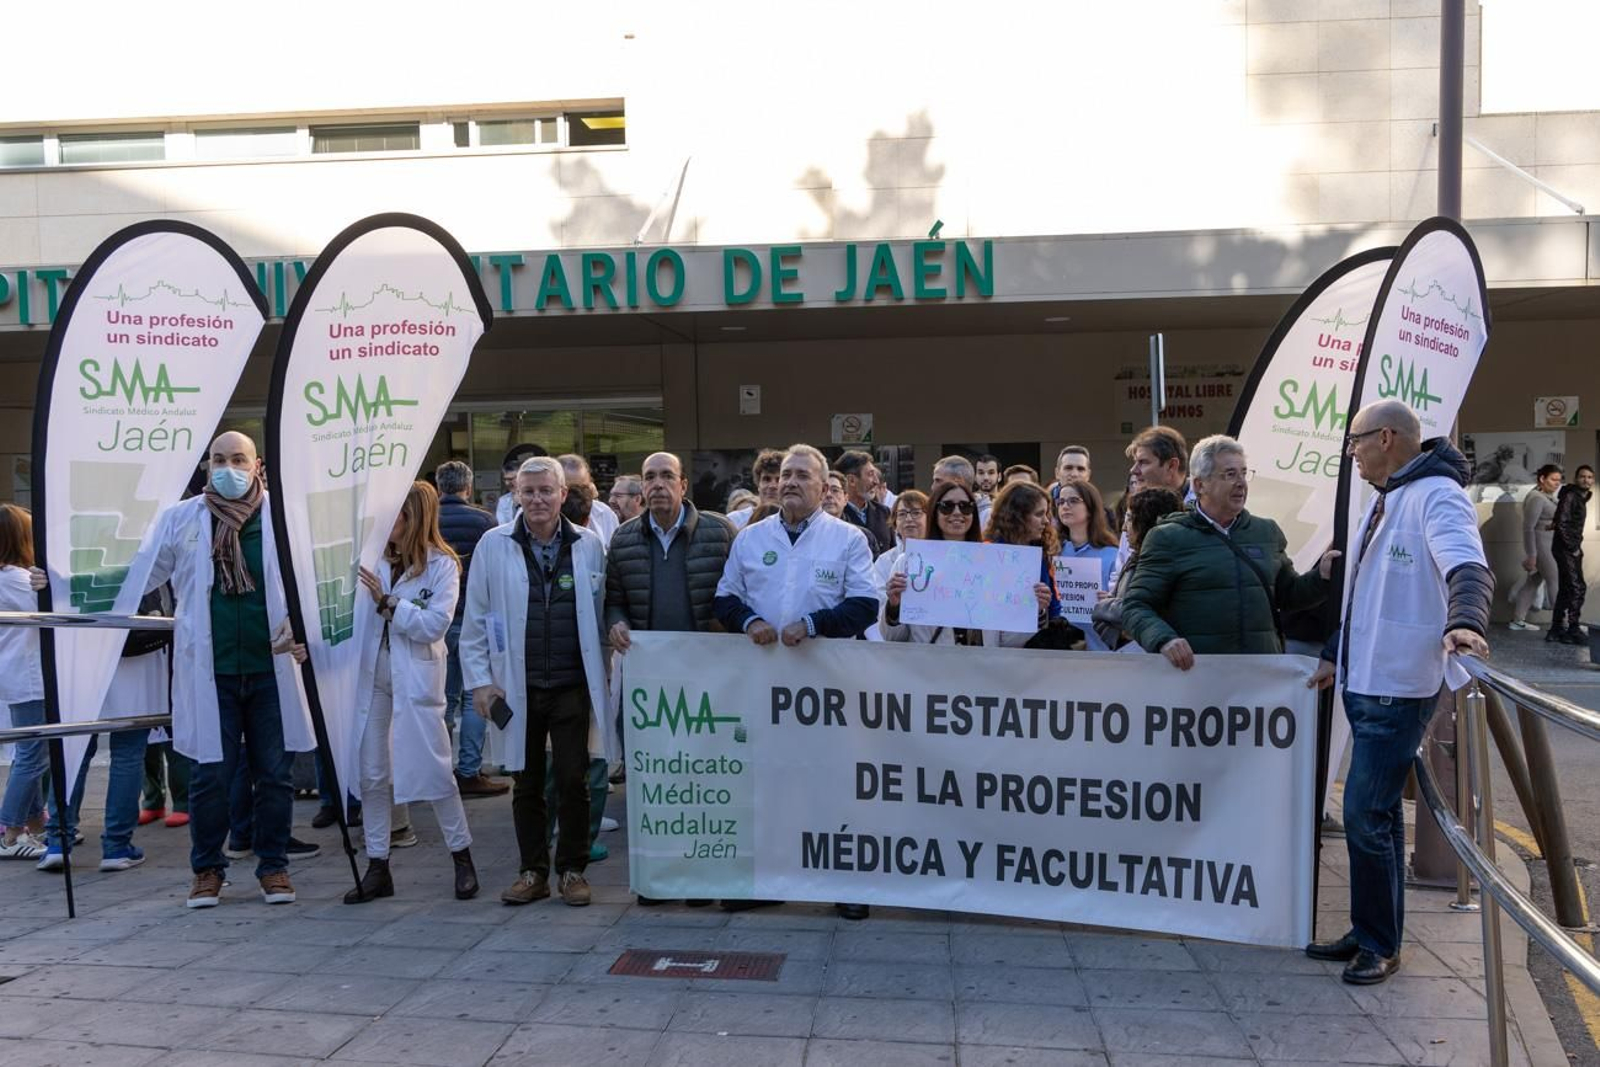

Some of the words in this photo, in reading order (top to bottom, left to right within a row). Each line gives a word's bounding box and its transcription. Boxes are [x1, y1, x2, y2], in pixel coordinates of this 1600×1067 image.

[722, 246, 805, 306] DE
[834, 219, 995, 301] JAÉN
[107, 310, 143, 326] Una
[150, 314, 233, 330] profesión
[329, 323, 364, 339] Una
[371, 320, 456, 339] profesión
[1400, 305, 1422, 325] Una
[1424, 315, 1470, 342] profesión
[107, 333, 130, 344] un
[136, 331, 219, 348] sindicato
[329, 347, 352, 361] un
[358, 341, 440, 359] sindicato
[1318, 333, 1352, 352] Una
[1399, 329, 1413, 344] un
[1415, 332, 1460, 358] sindicato
[1312, 355, 1334, 369] un
[79, 356, 200, 406] SMA
[1195, 383, 1233, 398] LIBRE
[1378, 354, 1442, 412] SMA
[82, 406, 125, 416] Sindicato
[162, 407, 197, 416] Andaluz
[303, 373, 419, 427] SMA
[1273, 379, 1348, 432] SM
[97, 419, 193, 452] Jaén
[311, 430, 352, 443] Sindicato
[1272, 425, 1310, 438] Sindicato
[328, 434, 408, 478] Jaén
[631, 685, 741, 737] SMA
[771, 686, 847, 727] POR
[859, 691, 912, 733] UN
[926, 693, 1130, 743] ESTATUTO
[1144, 705, 1297, 749] PROPIO
[634, 750, 743, 776] Sindicato
[642, 782, 731, 806] Médico
[856, 762, 903, 802] DE
[917, 767, 963, 807] LA
[976, 771, 1202, 822] PROFESION
[641, 812, 738, 837] Andaluz
[683, 838, 738, 860] Jaén
[802, 824, 946, 877] MÉDICA
[958, 840, 983, 879] Y
[996, 843, 1260, 909] FACULTATIVA
